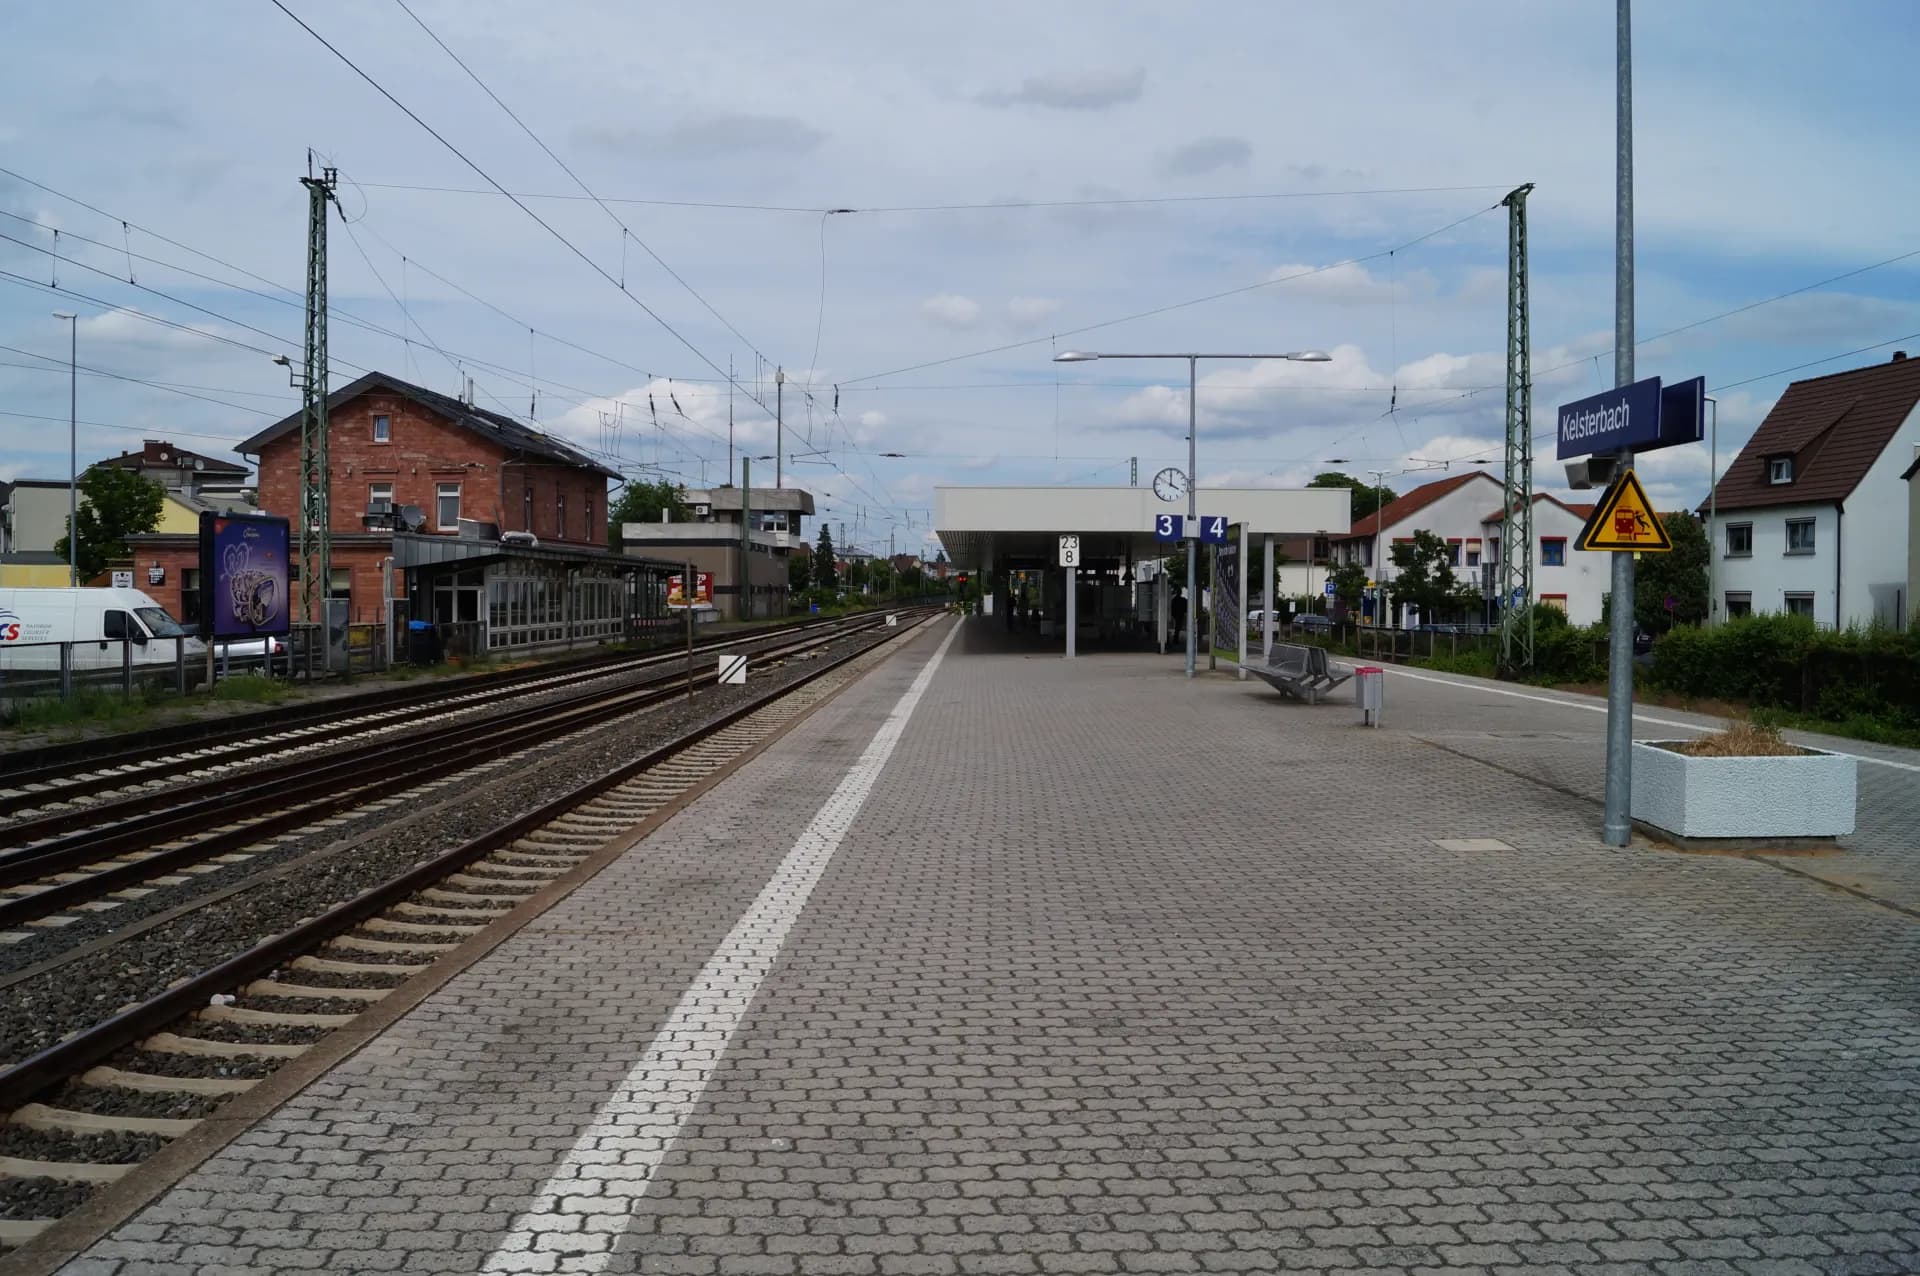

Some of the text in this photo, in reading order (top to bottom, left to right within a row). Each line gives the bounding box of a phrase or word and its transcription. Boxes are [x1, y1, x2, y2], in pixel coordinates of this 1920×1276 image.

[1562, 397, 1630, 442] Kelsterbach
[1159, 515, 1173, 536] 3
[1210, 517, 1224, 538] 4
[1061, 535, 1078, 549] 23
[1065, 550, 1073, 563] 8
[1327, 584, 1335, 594] P
